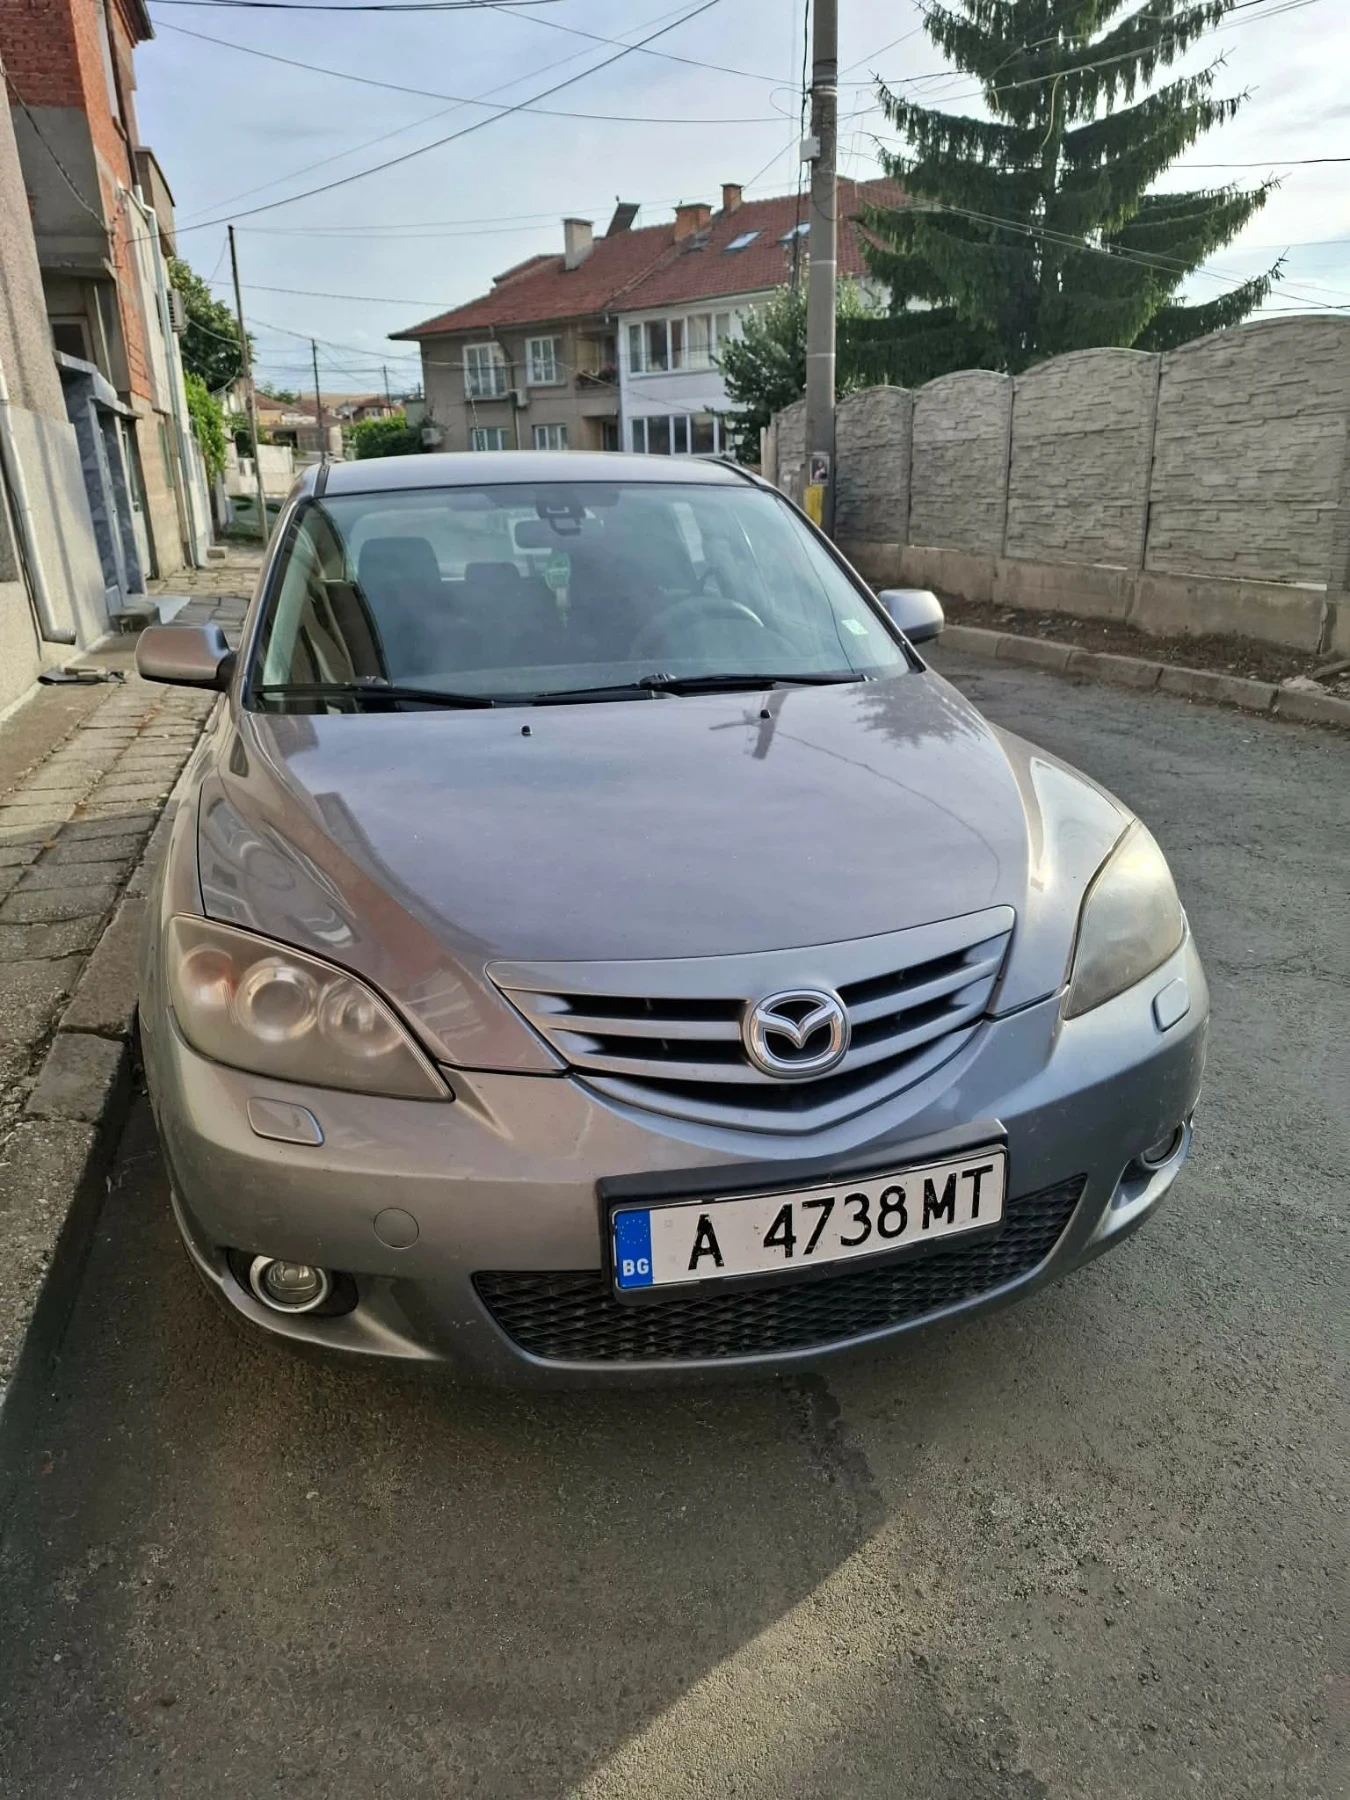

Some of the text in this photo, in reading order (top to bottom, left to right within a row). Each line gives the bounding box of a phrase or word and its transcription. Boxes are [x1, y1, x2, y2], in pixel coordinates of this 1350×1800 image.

[688, 1164, 994, 1271] A 4738 MT
[622, 1258, 649, 1276] BG
